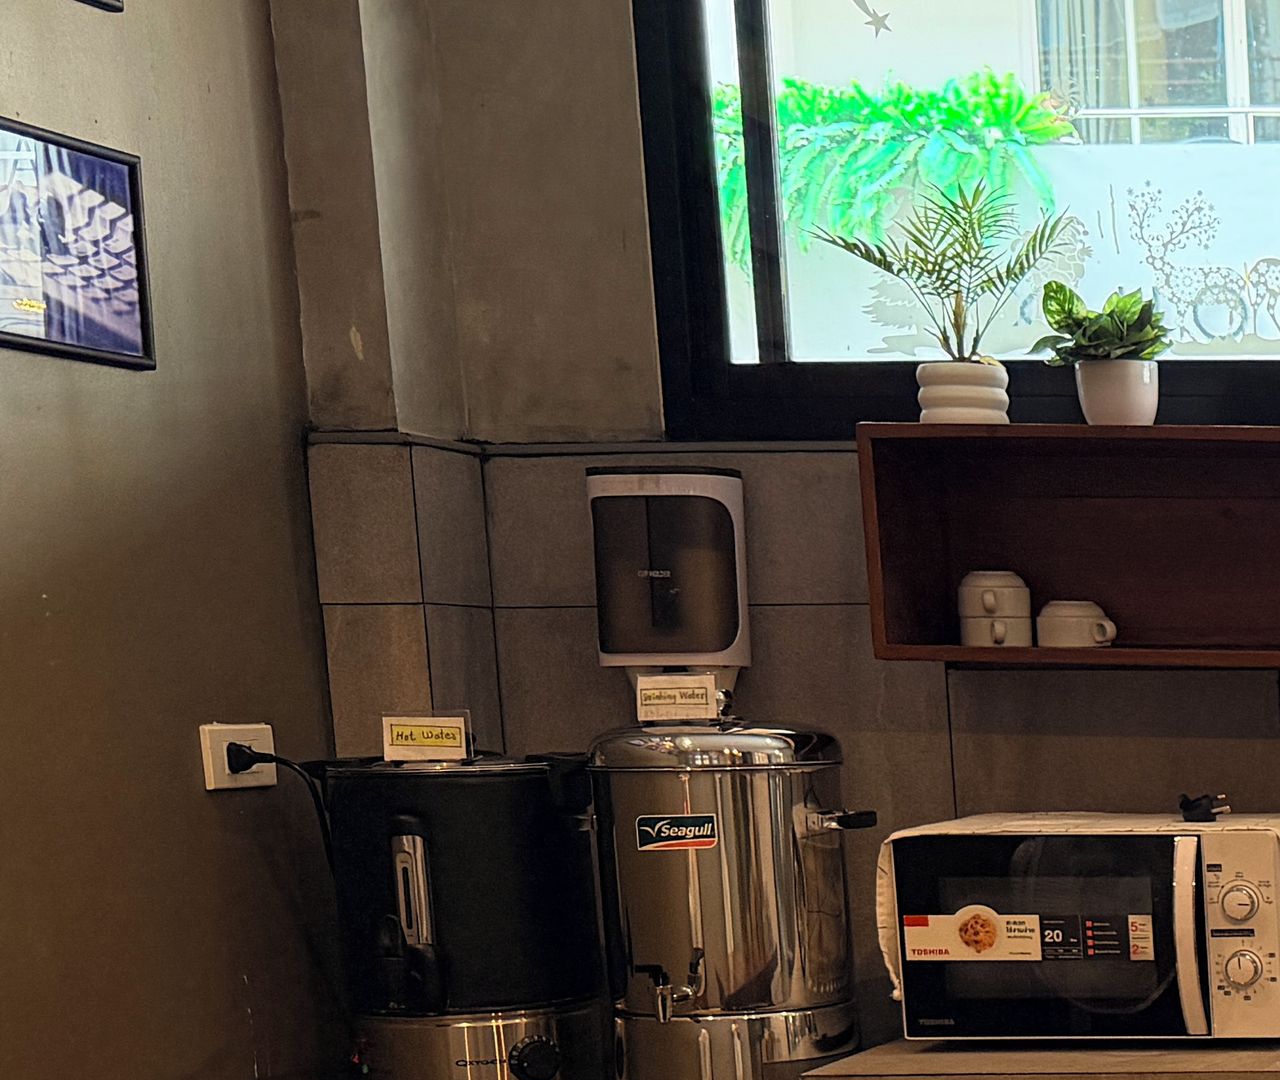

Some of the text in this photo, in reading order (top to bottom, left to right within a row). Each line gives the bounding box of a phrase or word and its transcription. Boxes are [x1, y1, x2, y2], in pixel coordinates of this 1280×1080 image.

[679, 690, 705, 700] Water
[396, 729, 457, 741] Hot Water
[660, 823, 712, 838] Seagull
[1130, 921, 1138, 932] 5
[1044, 929, 1063, 943] 20
[911, 948, 950, 956] TOSHIBA
[1132, 944, 1140, 955] 2
